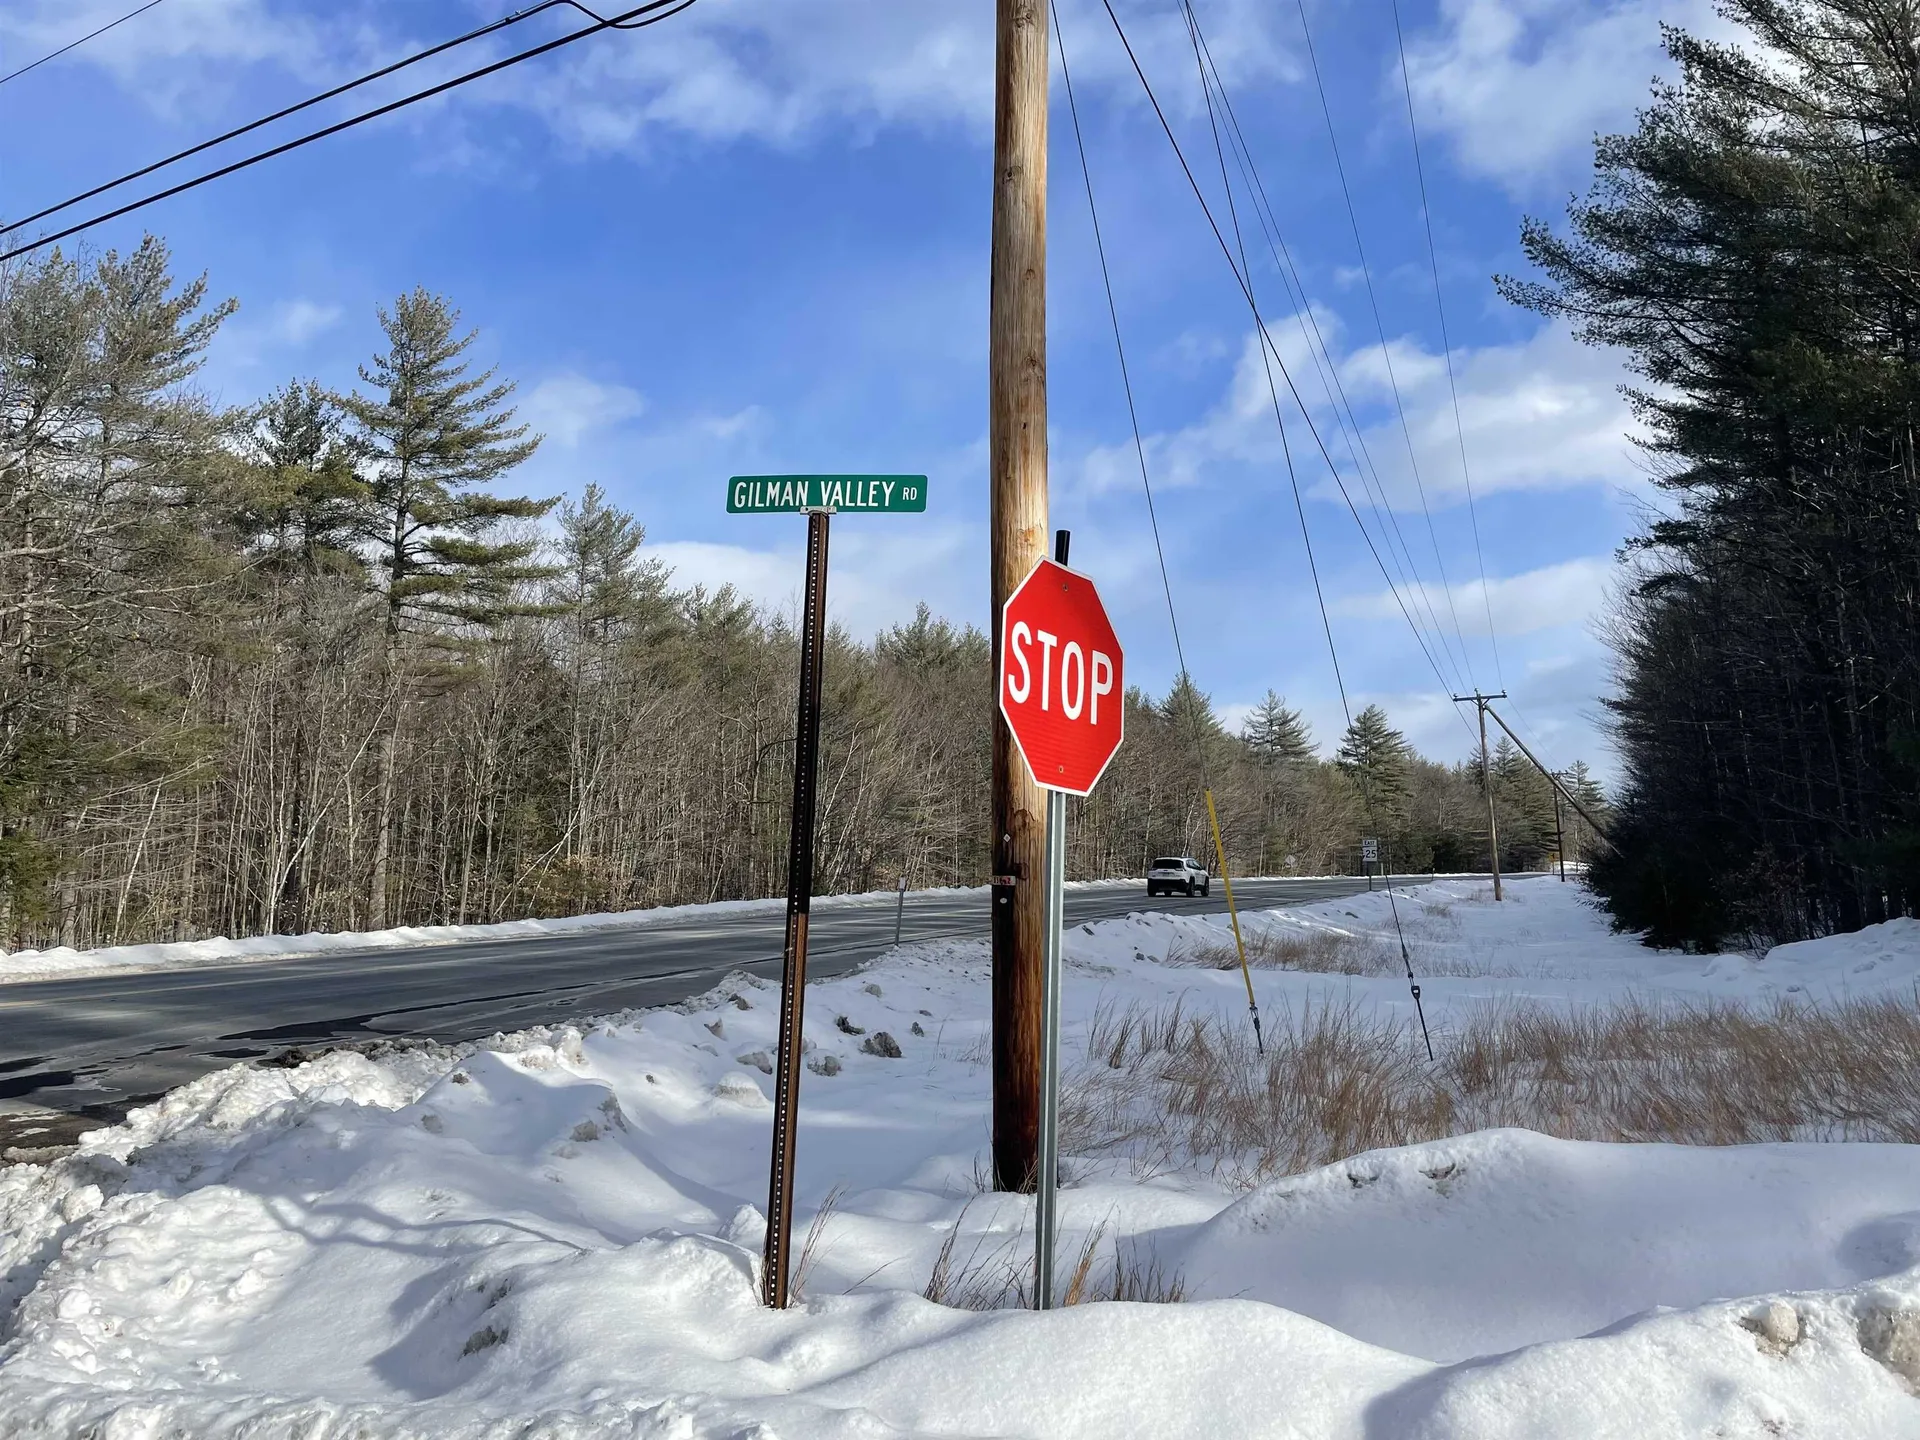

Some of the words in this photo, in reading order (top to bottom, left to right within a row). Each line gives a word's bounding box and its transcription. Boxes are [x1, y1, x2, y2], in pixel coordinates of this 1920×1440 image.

[734, 481, 809, 507] GILMAN
[820, 481, 896, 507] VALLEY
[902, 487, 917, 500] RD
[1008, 621, 1114, 725] STOP
[1365, 849, 1377, 859] 25
